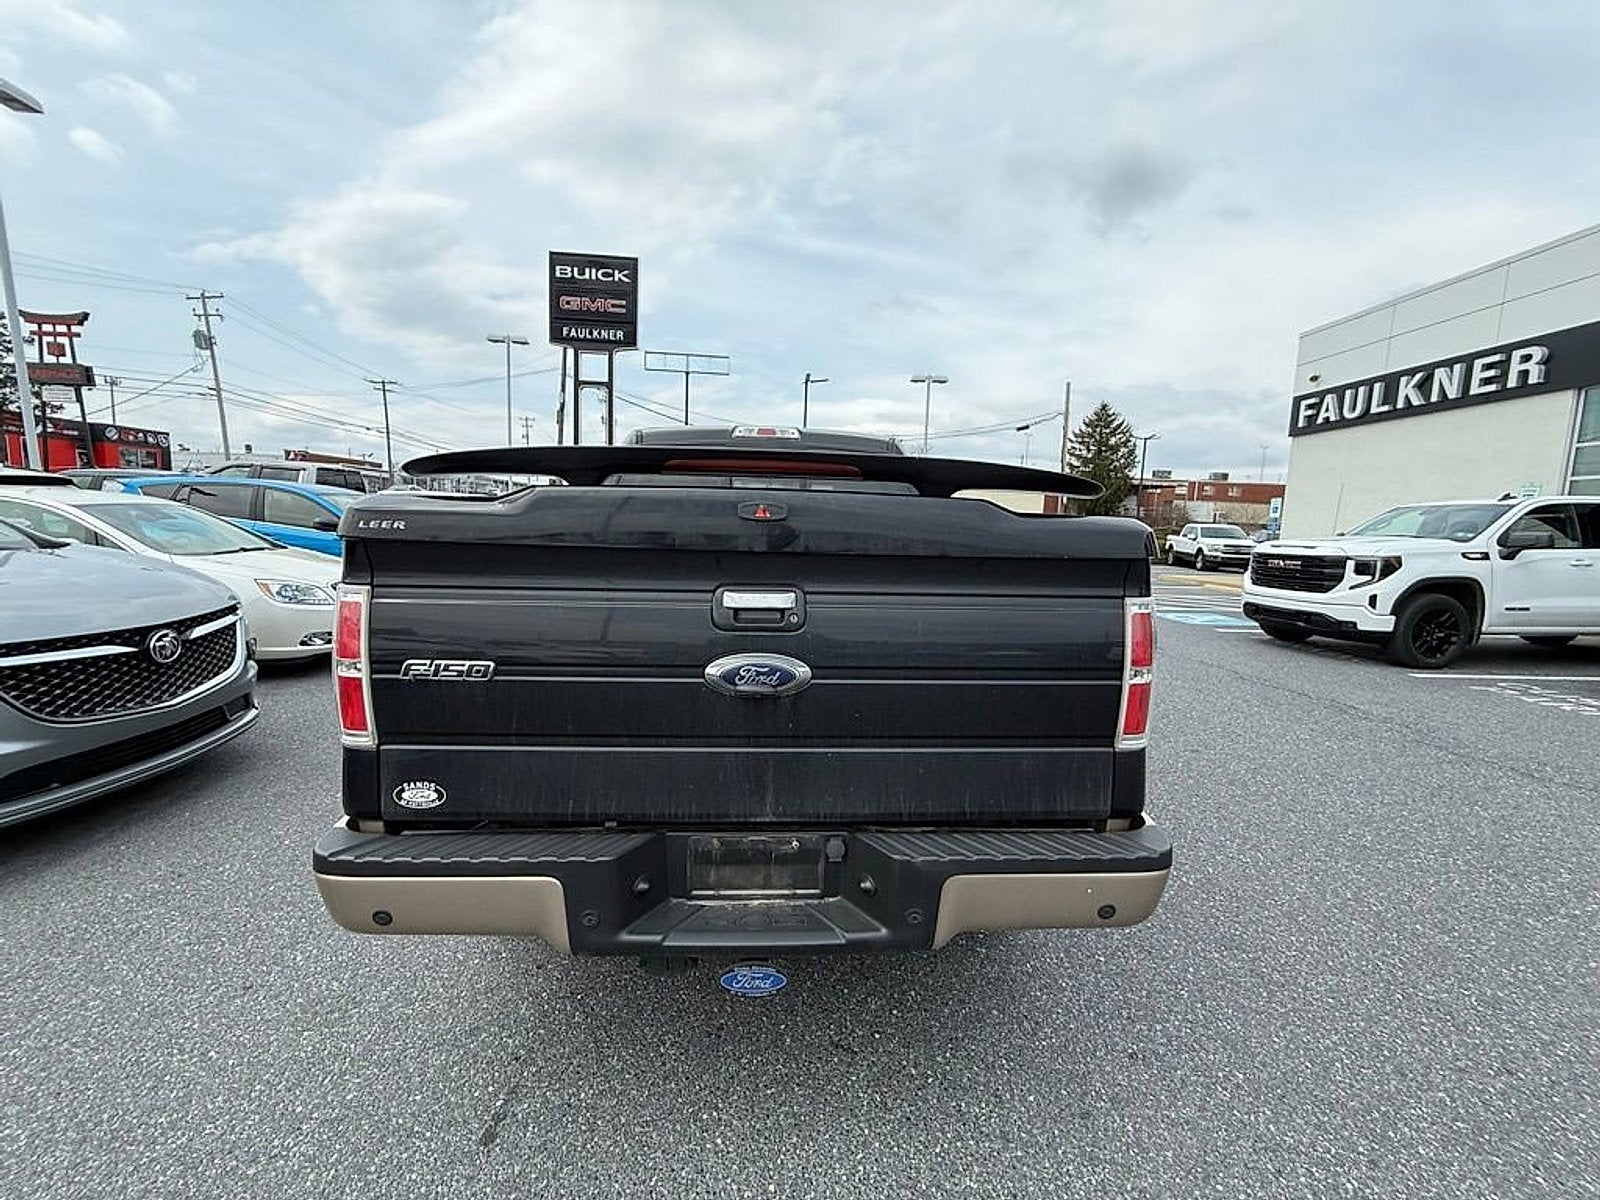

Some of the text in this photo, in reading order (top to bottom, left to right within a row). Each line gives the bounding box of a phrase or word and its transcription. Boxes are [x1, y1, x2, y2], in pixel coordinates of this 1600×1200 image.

[555, 265, 632, 283] BUICK
[559, 295, 627, 314] GMC
[562, 326, 624, 341] FAULKNER
[1297, 345, 1550, 428] FAULKNER
[358, 520, 406, 530] LEER
[400, 659, 496, 681] F-150
[734, 664, 781, 686] Ford
[732, 973, 774, 988] Ford
